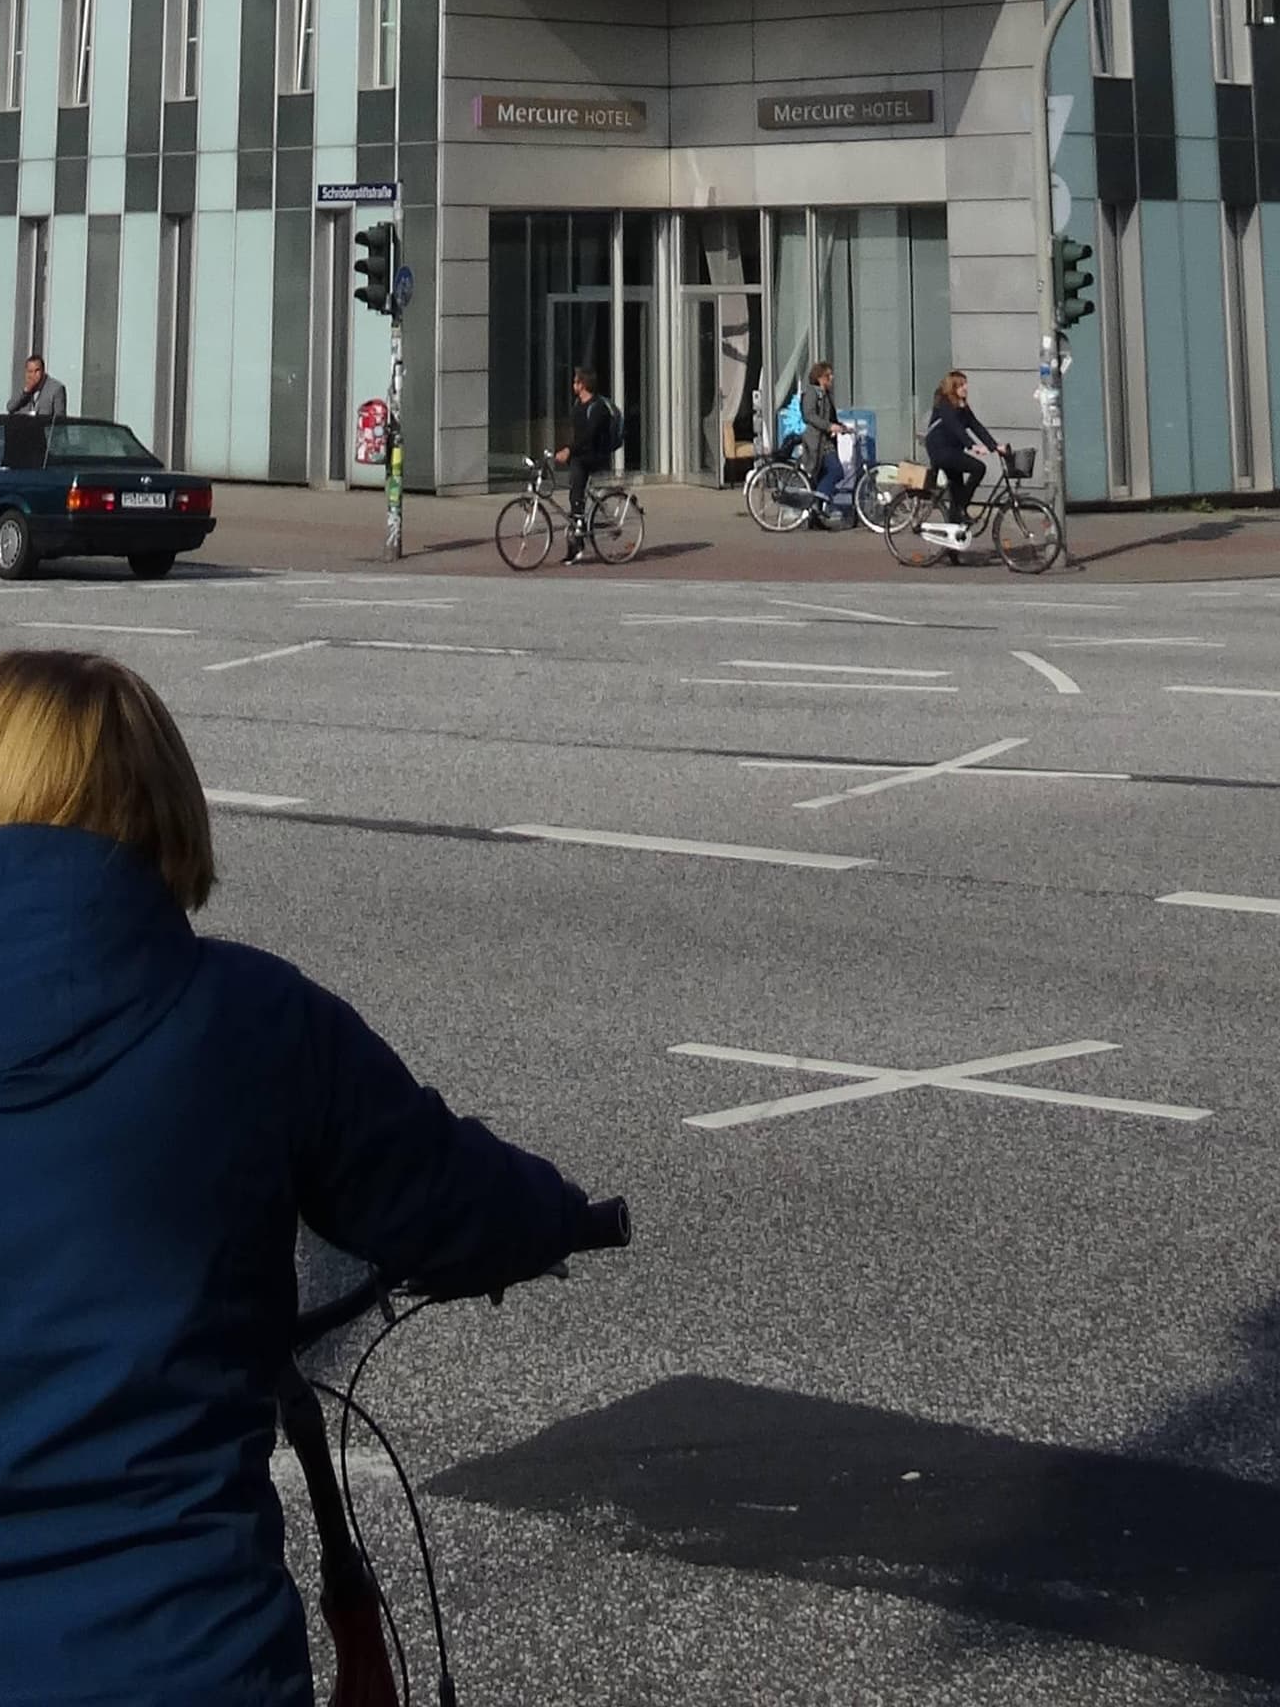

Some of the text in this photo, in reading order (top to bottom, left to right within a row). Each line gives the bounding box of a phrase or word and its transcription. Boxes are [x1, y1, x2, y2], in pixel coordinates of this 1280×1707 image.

[497, 102, 633, 126] Mercure HOTEL
[773, 101, 913, 122] Mercure HOTEL
[321, 185, 393, 199] Schröderstiftstraße
